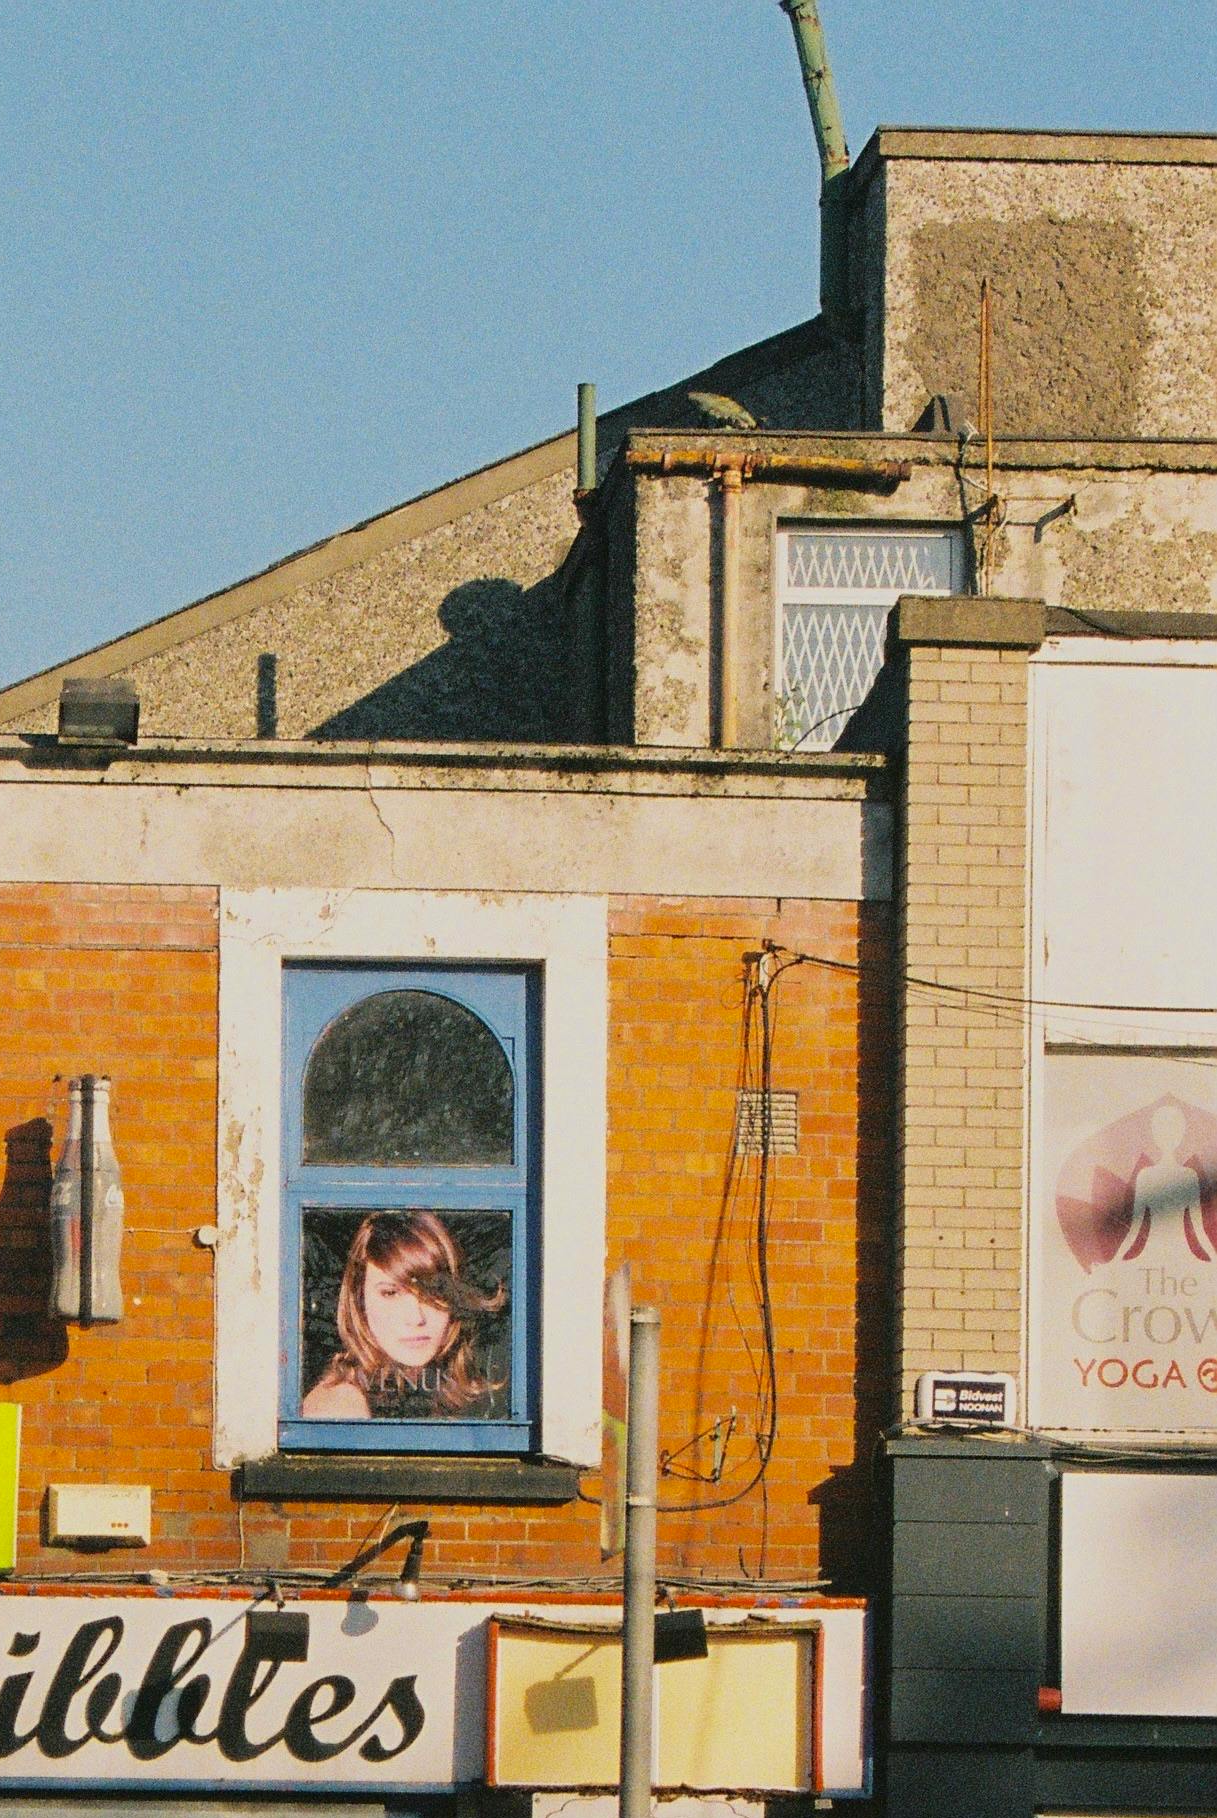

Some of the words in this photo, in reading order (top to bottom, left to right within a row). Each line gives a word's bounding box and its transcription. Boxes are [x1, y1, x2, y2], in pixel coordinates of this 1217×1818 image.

[1138, 1267, 1198, 1296] The
[358, 1367, 458, 1393] VENUS
[1073, 1358, 1187, 1389] YOGA
[959, 1389, 1003, 1402] Bidvest
[959, 1403, 1002, 1412] NOONAN
